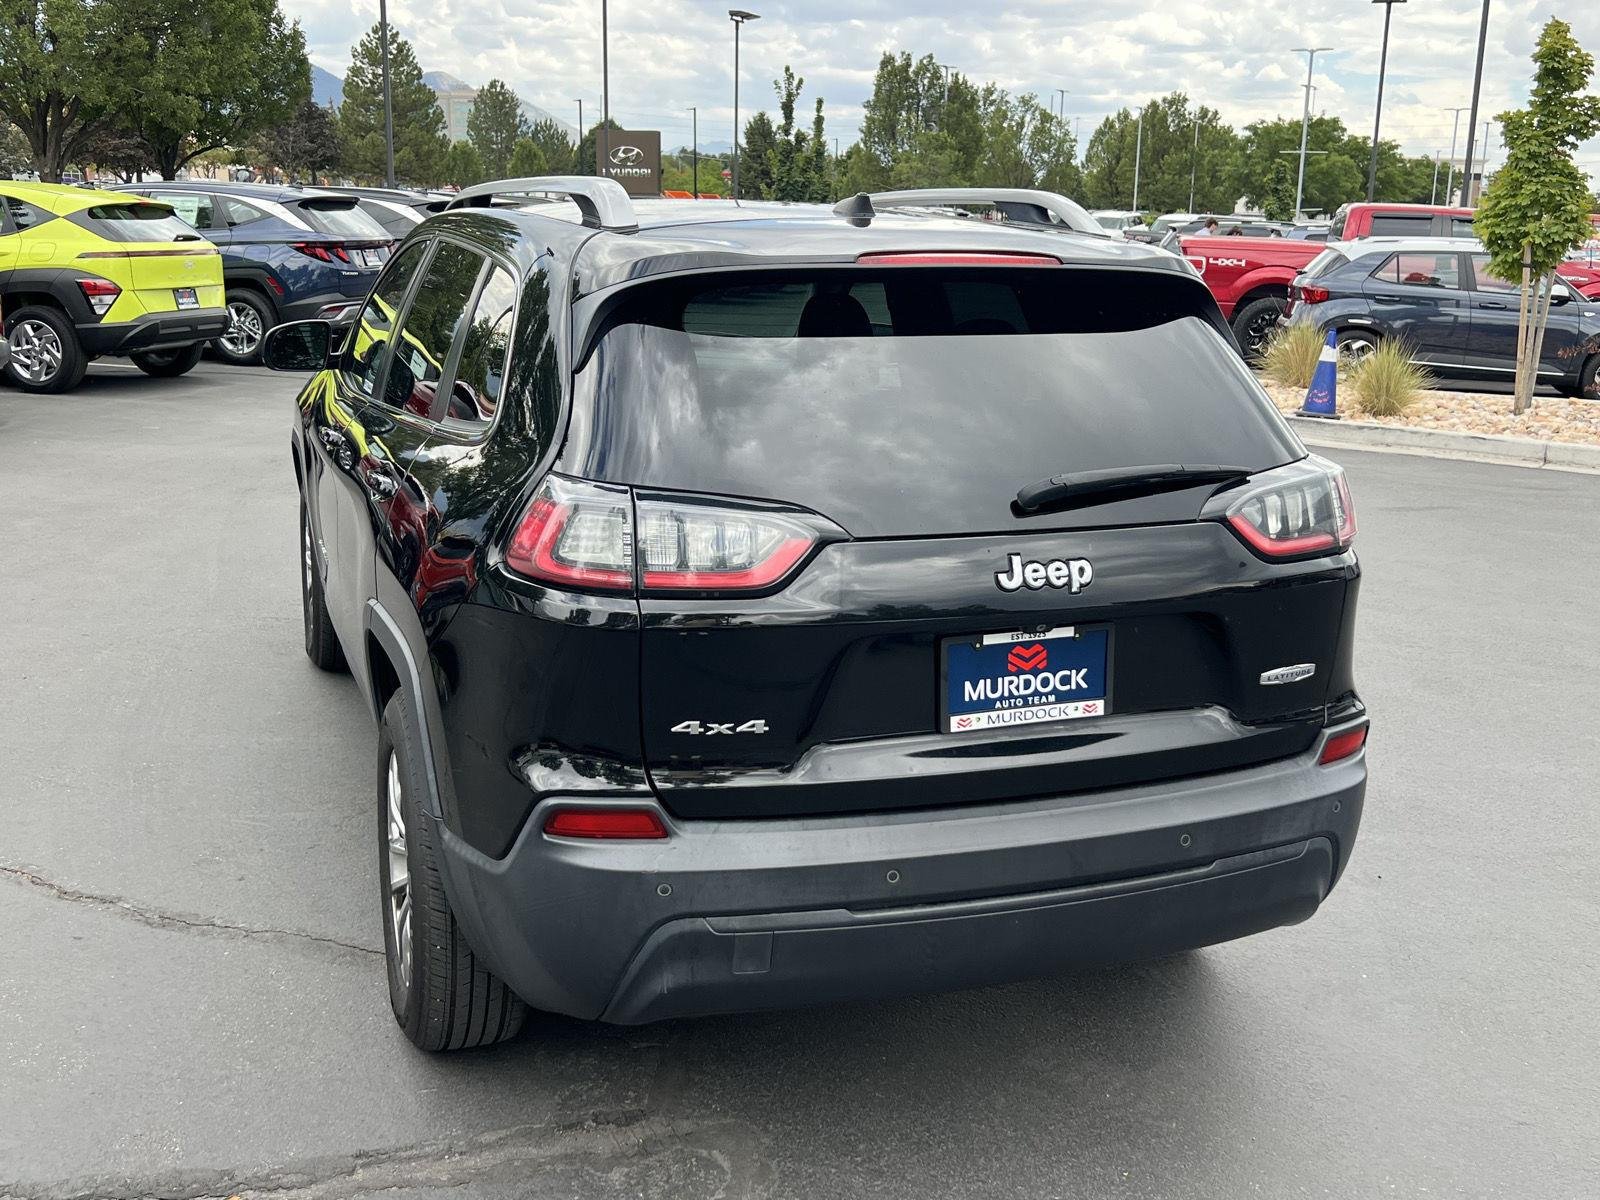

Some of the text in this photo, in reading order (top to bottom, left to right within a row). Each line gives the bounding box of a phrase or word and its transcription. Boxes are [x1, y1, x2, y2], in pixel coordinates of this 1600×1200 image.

[994, 552, 1093, 595] Jeep
[964, 668, 1088, 701] MURDOCK
[1267, 668, 1312, 681] LATITUDE
[995, 694, 1056, 709] AUTO TEAM
[987, 705, 1069, 725] MURDOCK
